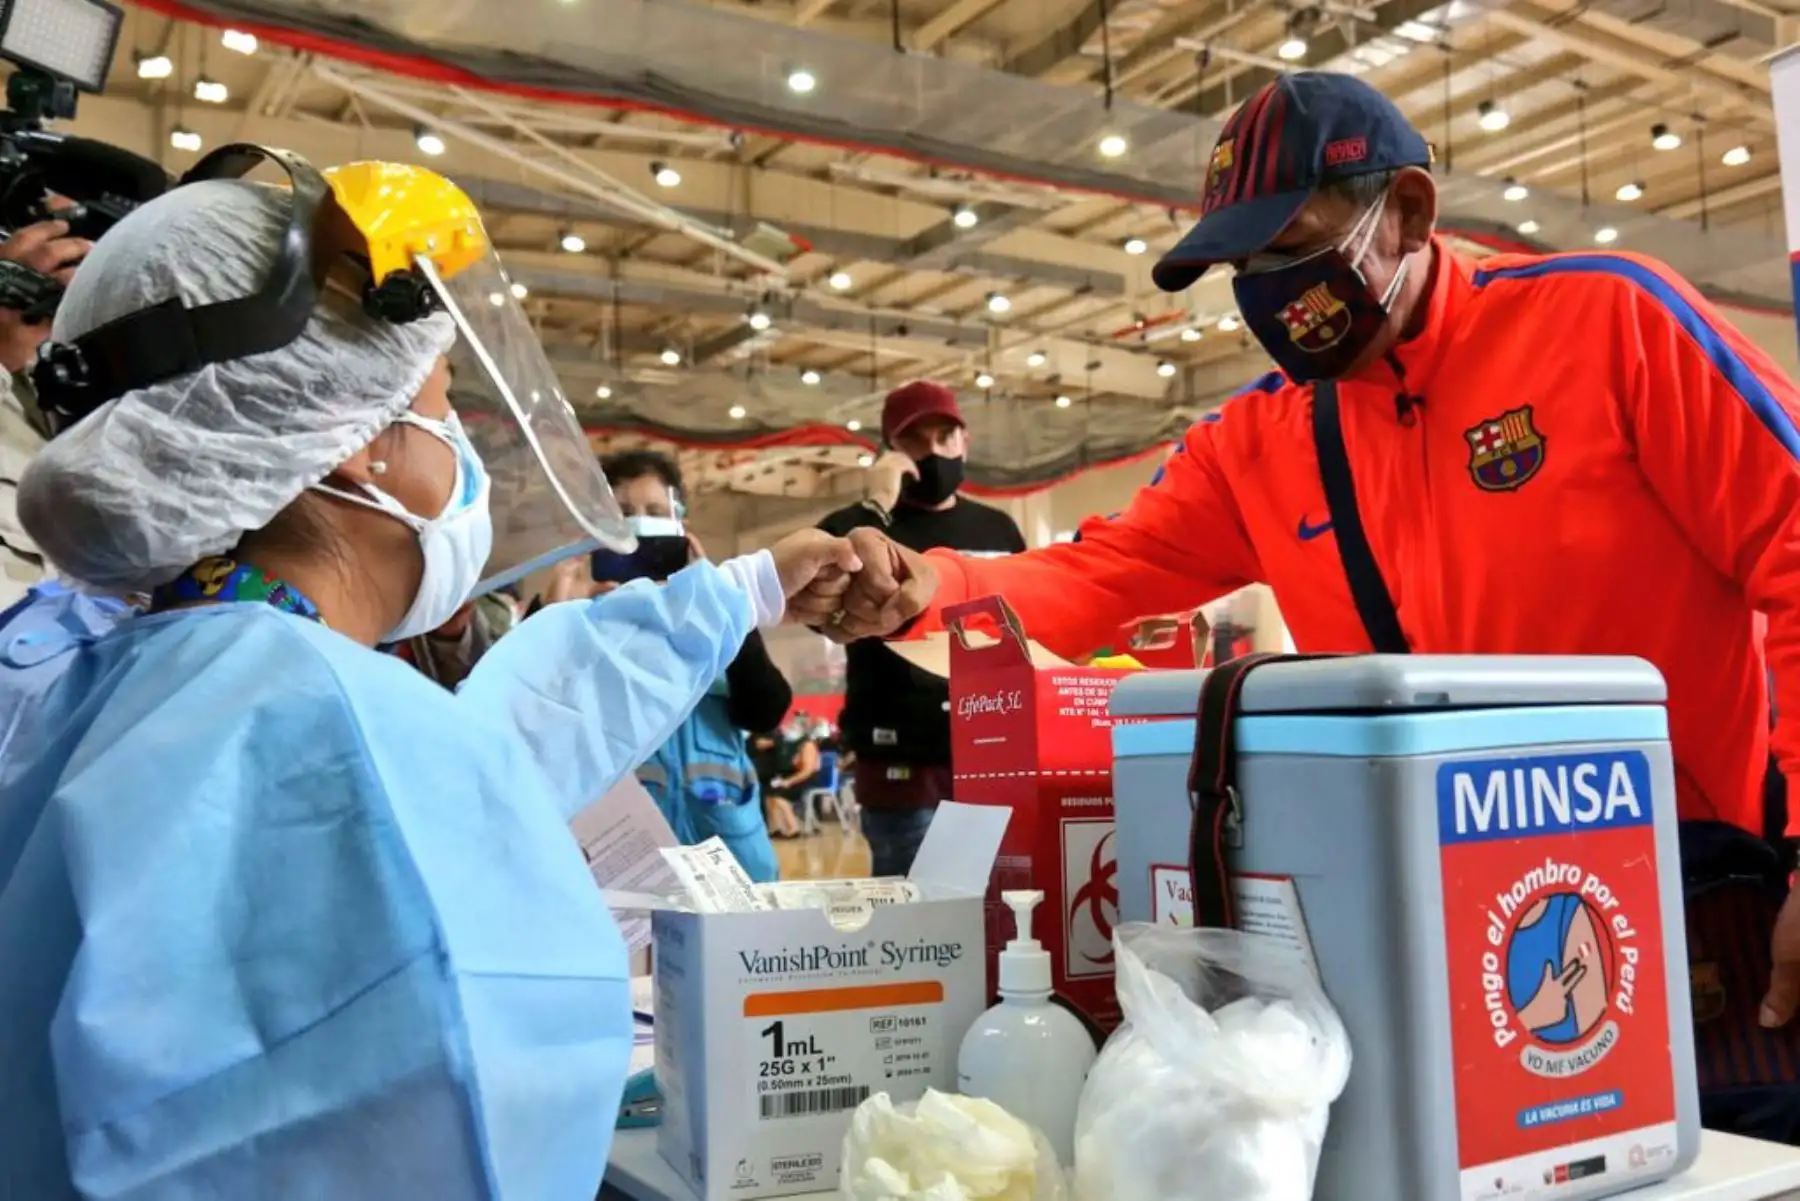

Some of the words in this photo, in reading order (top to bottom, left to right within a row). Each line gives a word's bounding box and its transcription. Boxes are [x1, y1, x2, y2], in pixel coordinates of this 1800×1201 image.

[958, 690, 1007, 721] LifePack
[1086, 697, 1108, 706] CUMP
[1453, 761, 1641, 834] MINSA
[1496, 857, 1582, 918] hombro
[1580, 873, 1620, 911] por
[1487, 910, 1506, 946] el
[1611, 913, 1637, 939] el
[880, 938, 962, 971] Syringe
[1615, 946, 1640, 1016] Perú
[1482, 951, 1517, 1048] Pongo
[872, 1018, 893, 1030] REF
[1527, 1051, 1543, 1069] YO
[1546, 1059, 1564, 1073] ME
[1567, 1029, 1614, 1071] VACUNO
[757, 1078, 804, 1092] (0.50mm
[807, 1079, 812, 1087] x
[816, 1073, 852, 1087] 25mm)
[759, 1060, 795, 1077] 25G
[801, 1061, 811, 1074] x
[1525, 1109, 1538, 1125] LA
[1539, 1102, 1579, 1121] VACUNA
[1580, 1098, 1592, 1112] ES
[1593, 1093, 1615, 1110] VIDA
